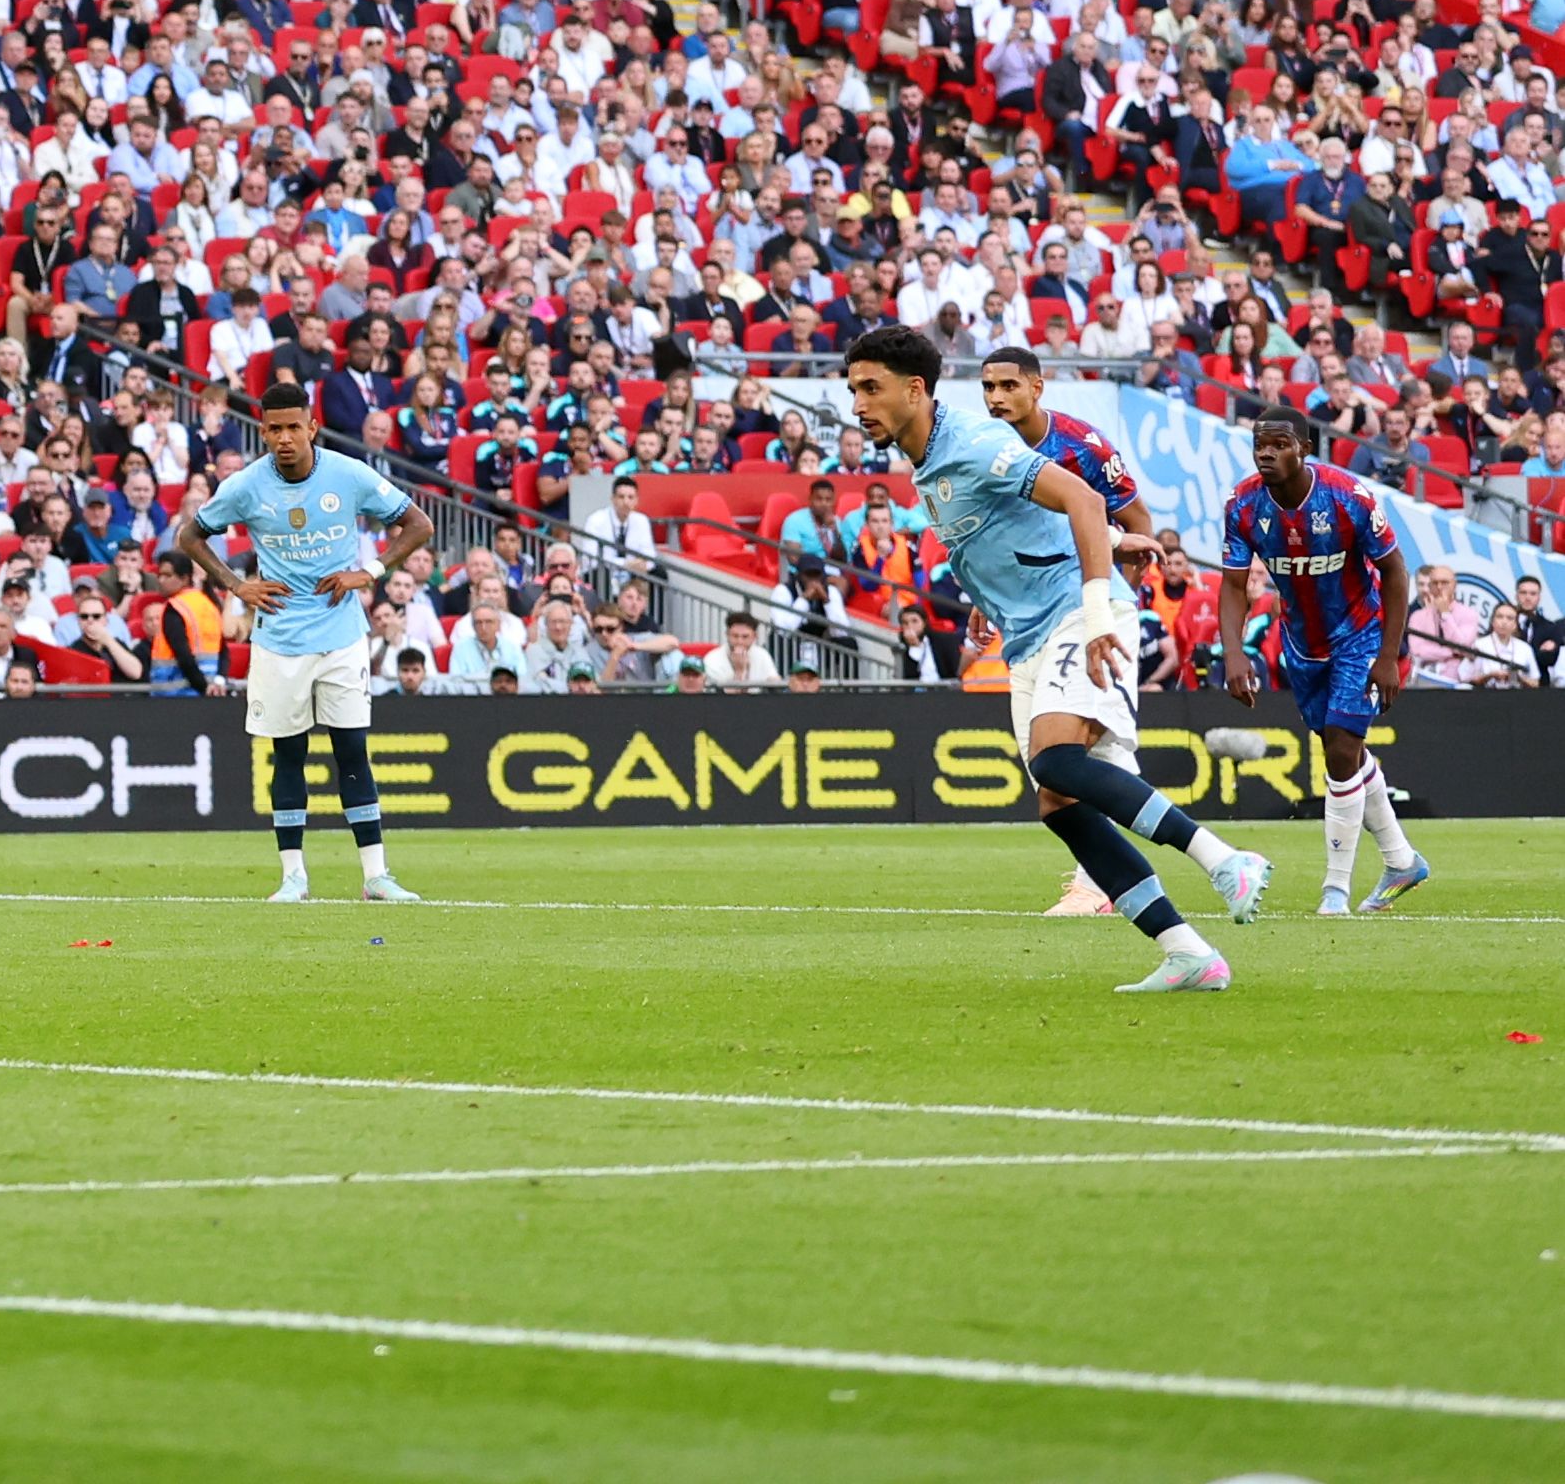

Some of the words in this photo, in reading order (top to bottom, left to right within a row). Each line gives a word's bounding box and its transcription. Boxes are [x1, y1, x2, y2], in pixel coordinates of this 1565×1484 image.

[260, 524, 348, 549] ETIHAD
[279, 544, 333, 562] AIRWAYS
[1055, 642, 1079, 678] 7
[487, 729, 897, 813] GAME
